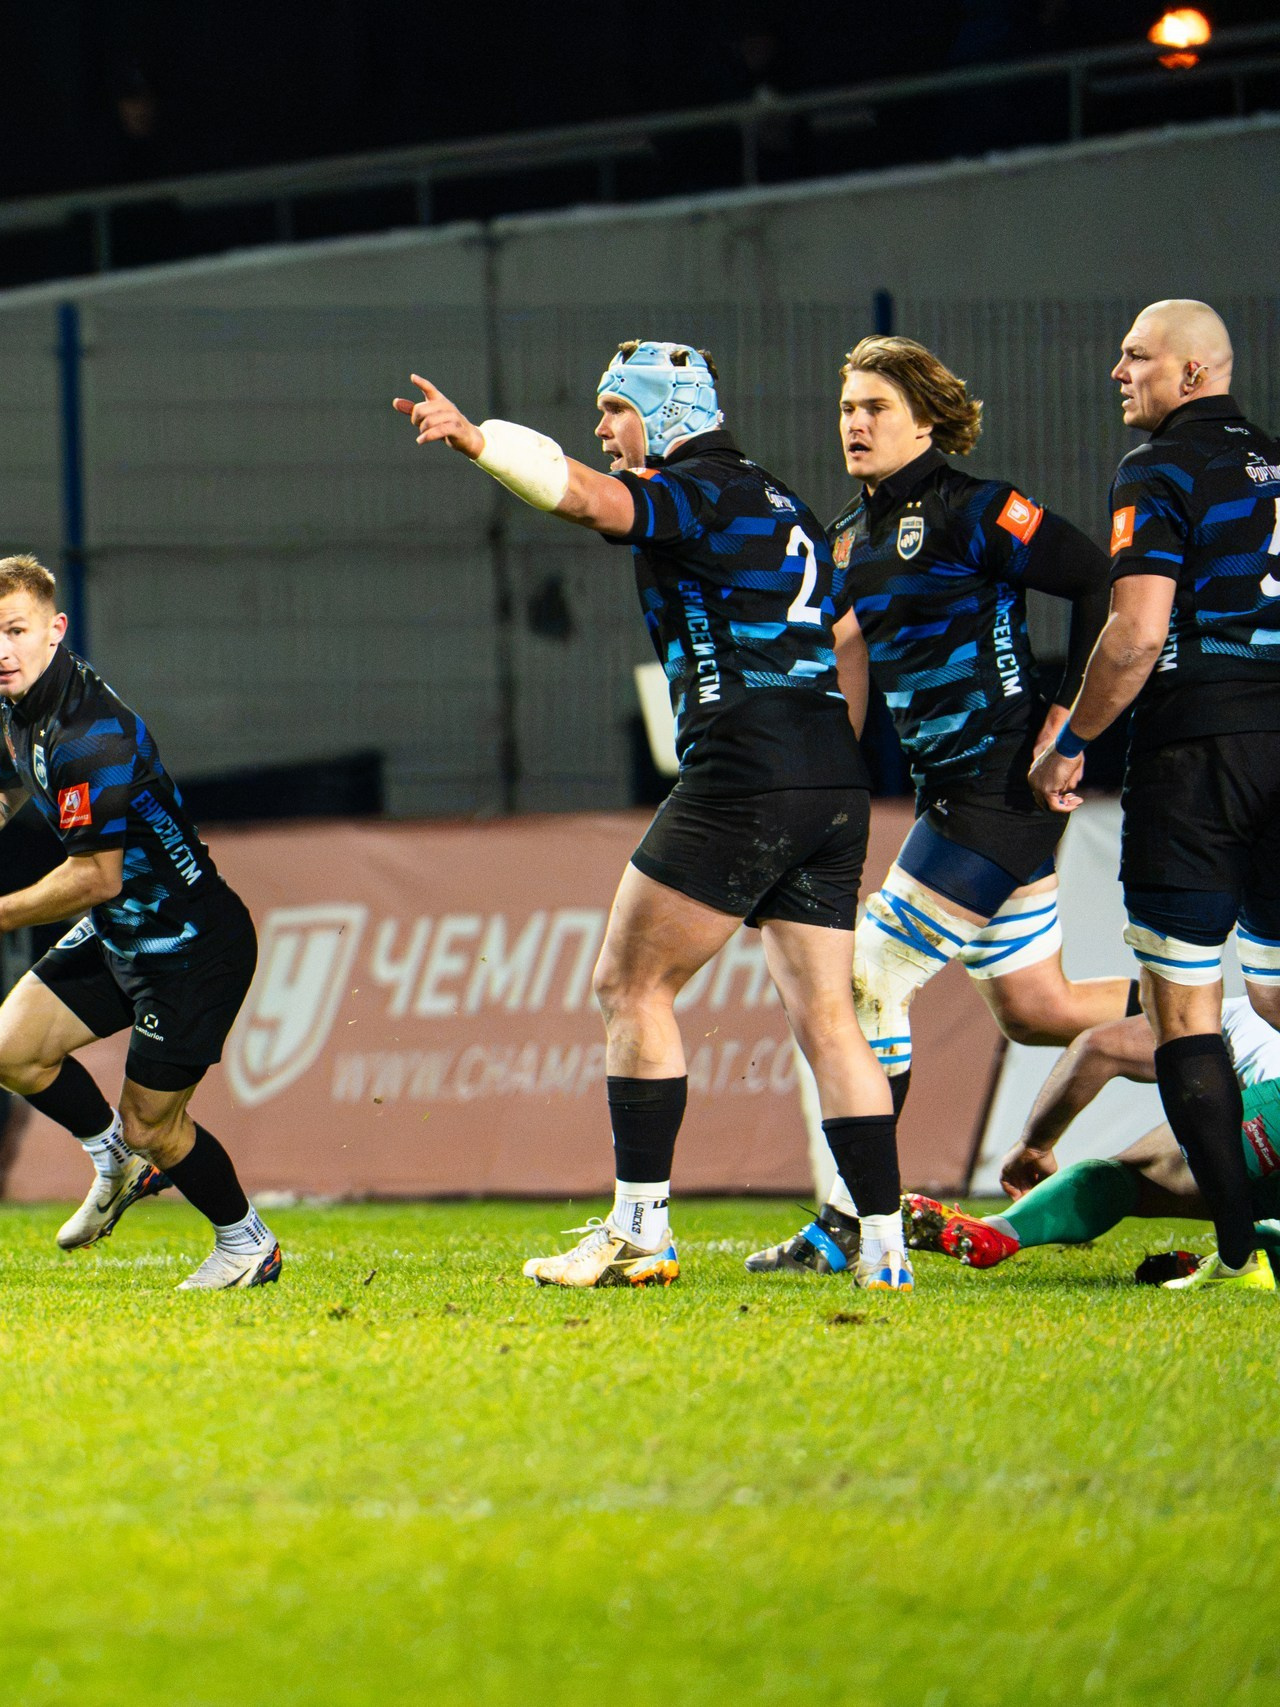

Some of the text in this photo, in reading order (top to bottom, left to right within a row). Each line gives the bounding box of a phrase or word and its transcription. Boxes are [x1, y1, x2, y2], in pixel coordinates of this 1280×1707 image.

[786, 525, 821, 625] 2
[698, 660, 721, 704] СТМ
[996, 653, 1023, 697] СТМ
[169, 844, 203, 886] СТМ
[135, 1025, 164, 1042] centurion
